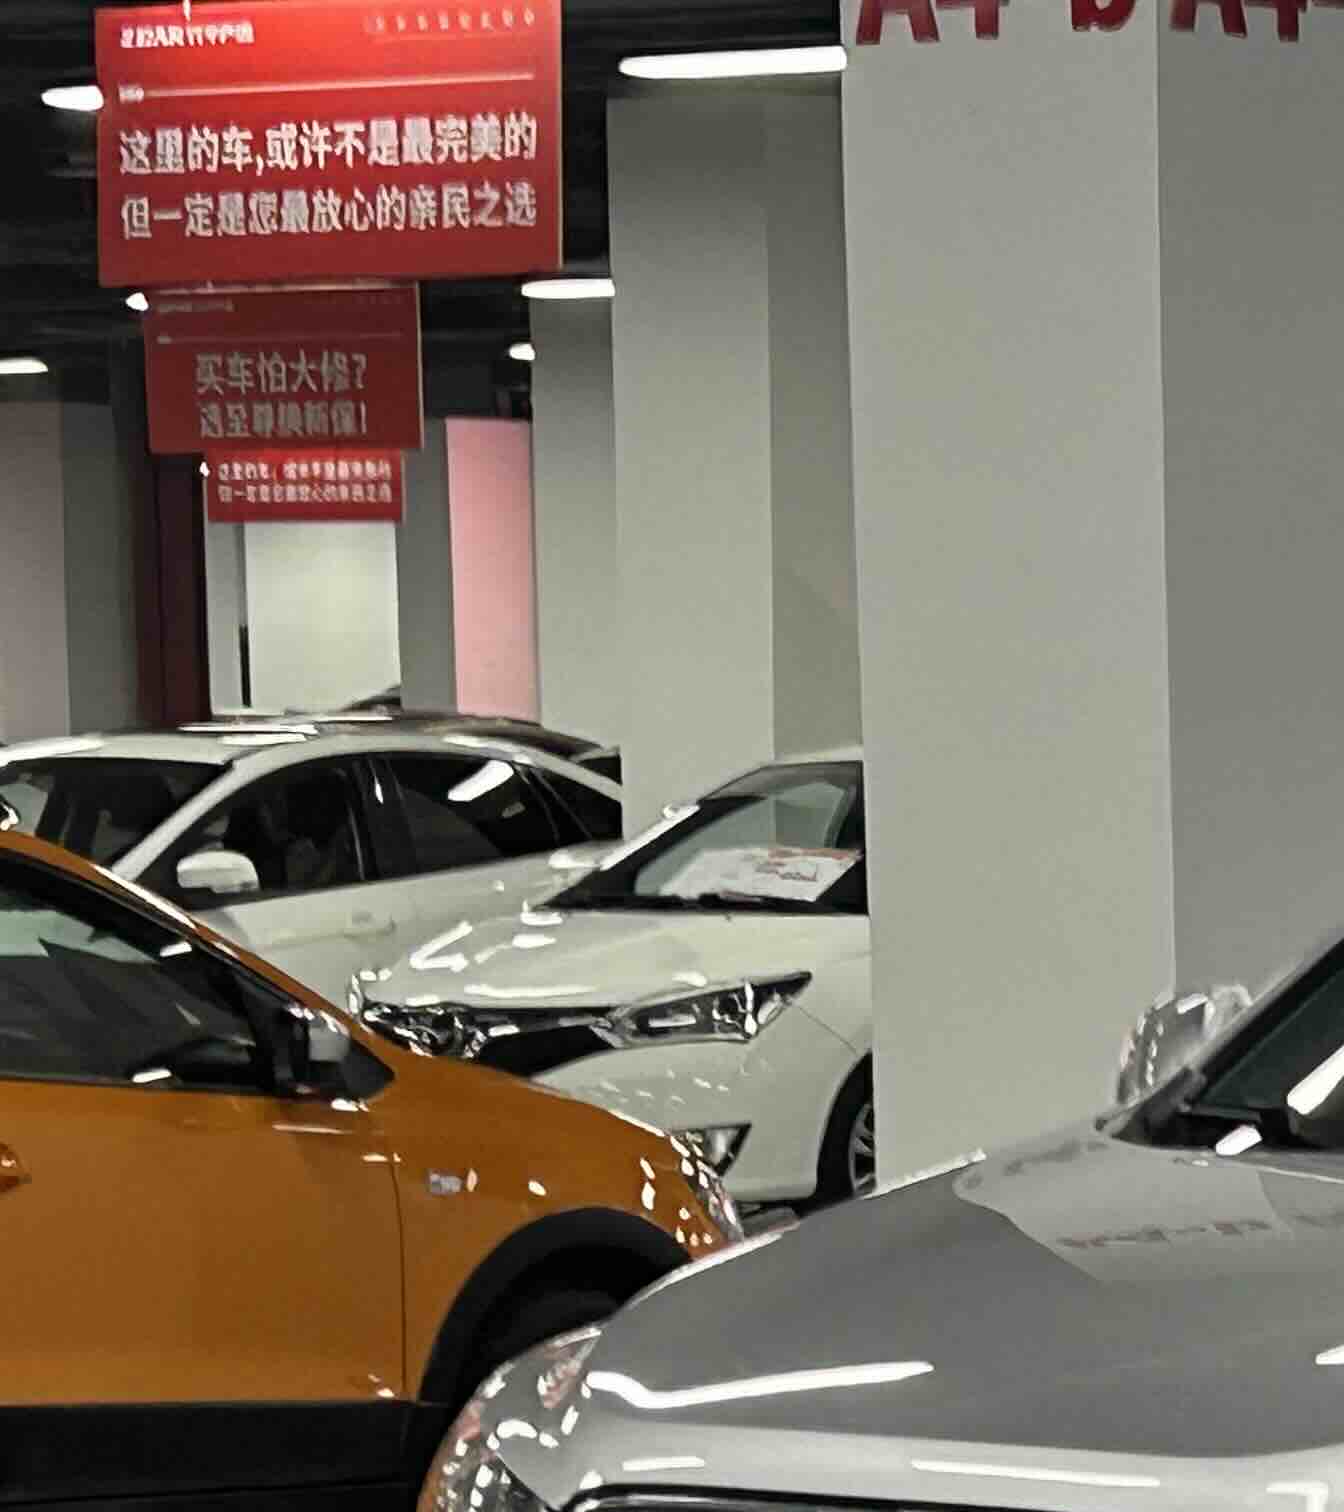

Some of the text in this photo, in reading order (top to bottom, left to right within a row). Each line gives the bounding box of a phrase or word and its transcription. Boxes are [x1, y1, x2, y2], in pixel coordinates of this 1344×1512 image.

[121, 180, 537, 239] 但一定是您最放心的亲民之选
